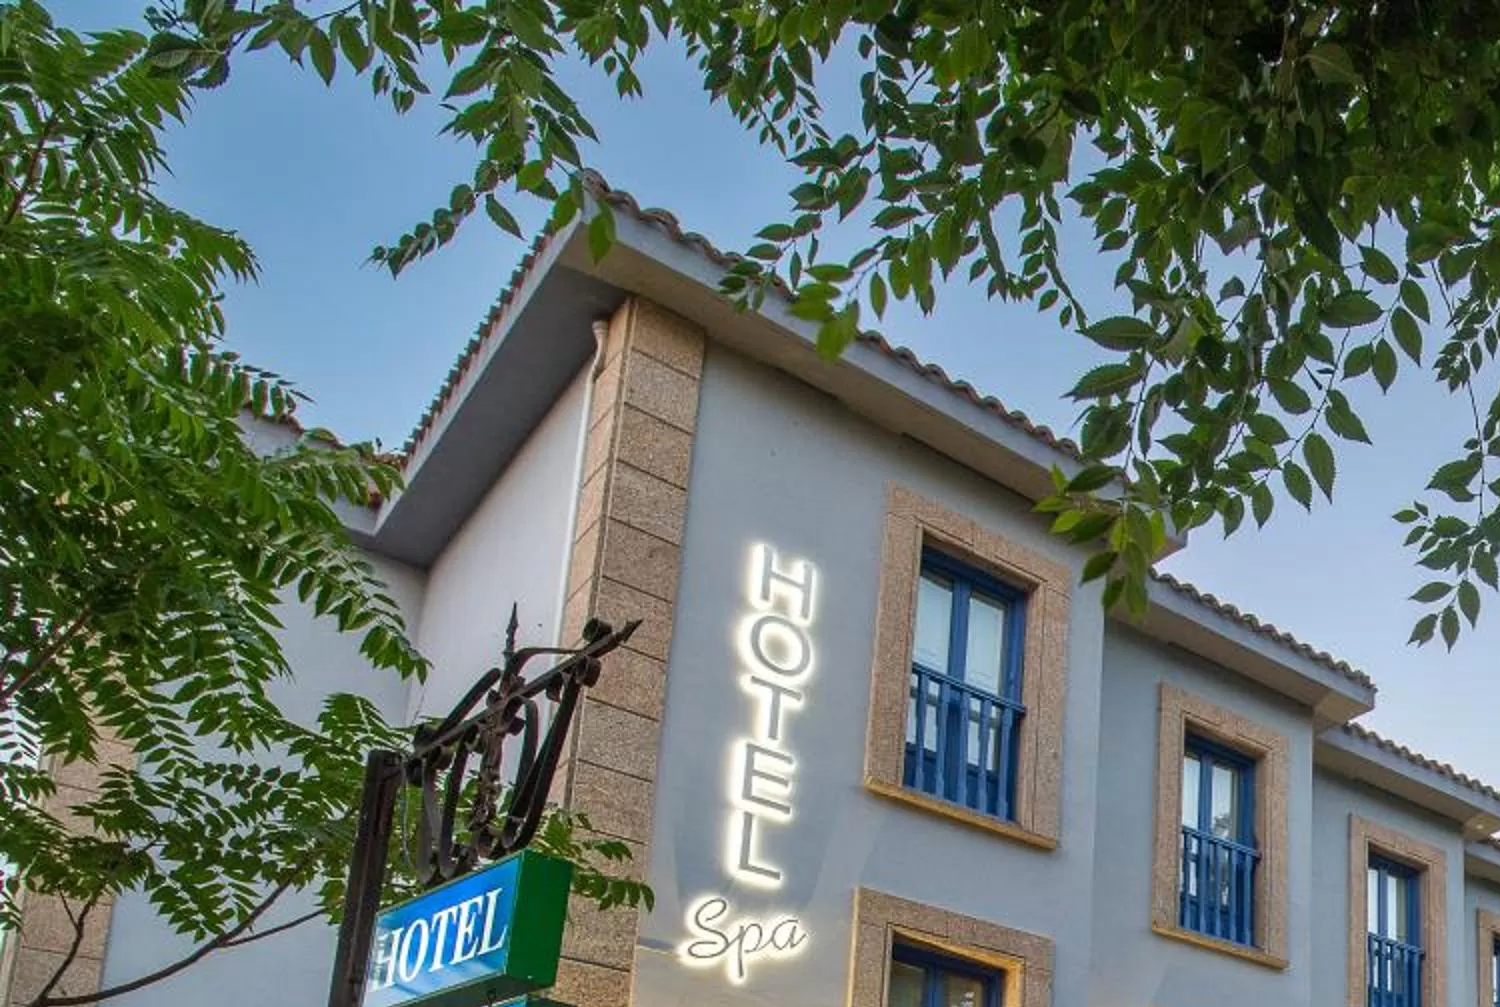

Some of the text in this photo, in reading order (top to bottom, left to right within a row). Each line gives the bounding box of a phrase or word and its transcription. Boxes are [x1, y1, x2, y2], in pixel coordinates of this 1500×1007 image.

[738, 544, 815, 881] HOTEL
[370, 887, 508, 992] HOTEL
[686, 898, 808, 978] Spa
